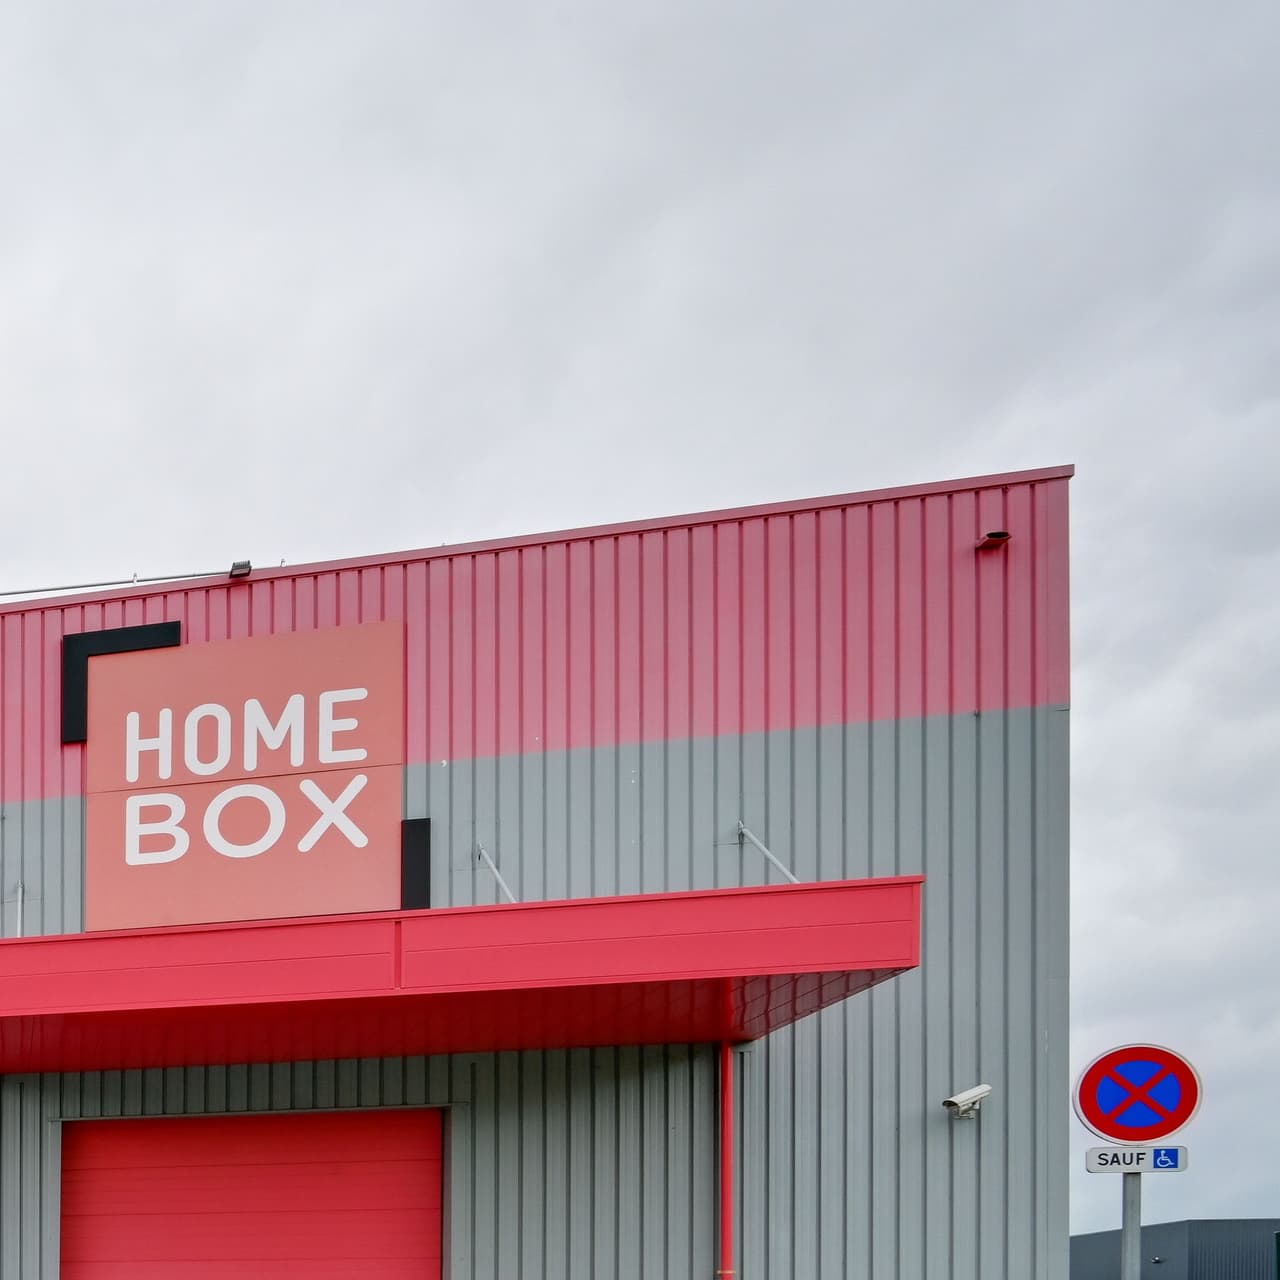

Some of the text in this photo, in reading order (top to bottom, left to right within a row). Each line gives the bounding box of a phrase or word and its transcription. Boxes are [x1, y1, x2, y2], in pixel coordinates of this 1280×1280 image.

[126, 687, 368, 783] HOME
[125, 774, 369, 866] BOX
[1097, 1152, 1147, 1167] SAUF
